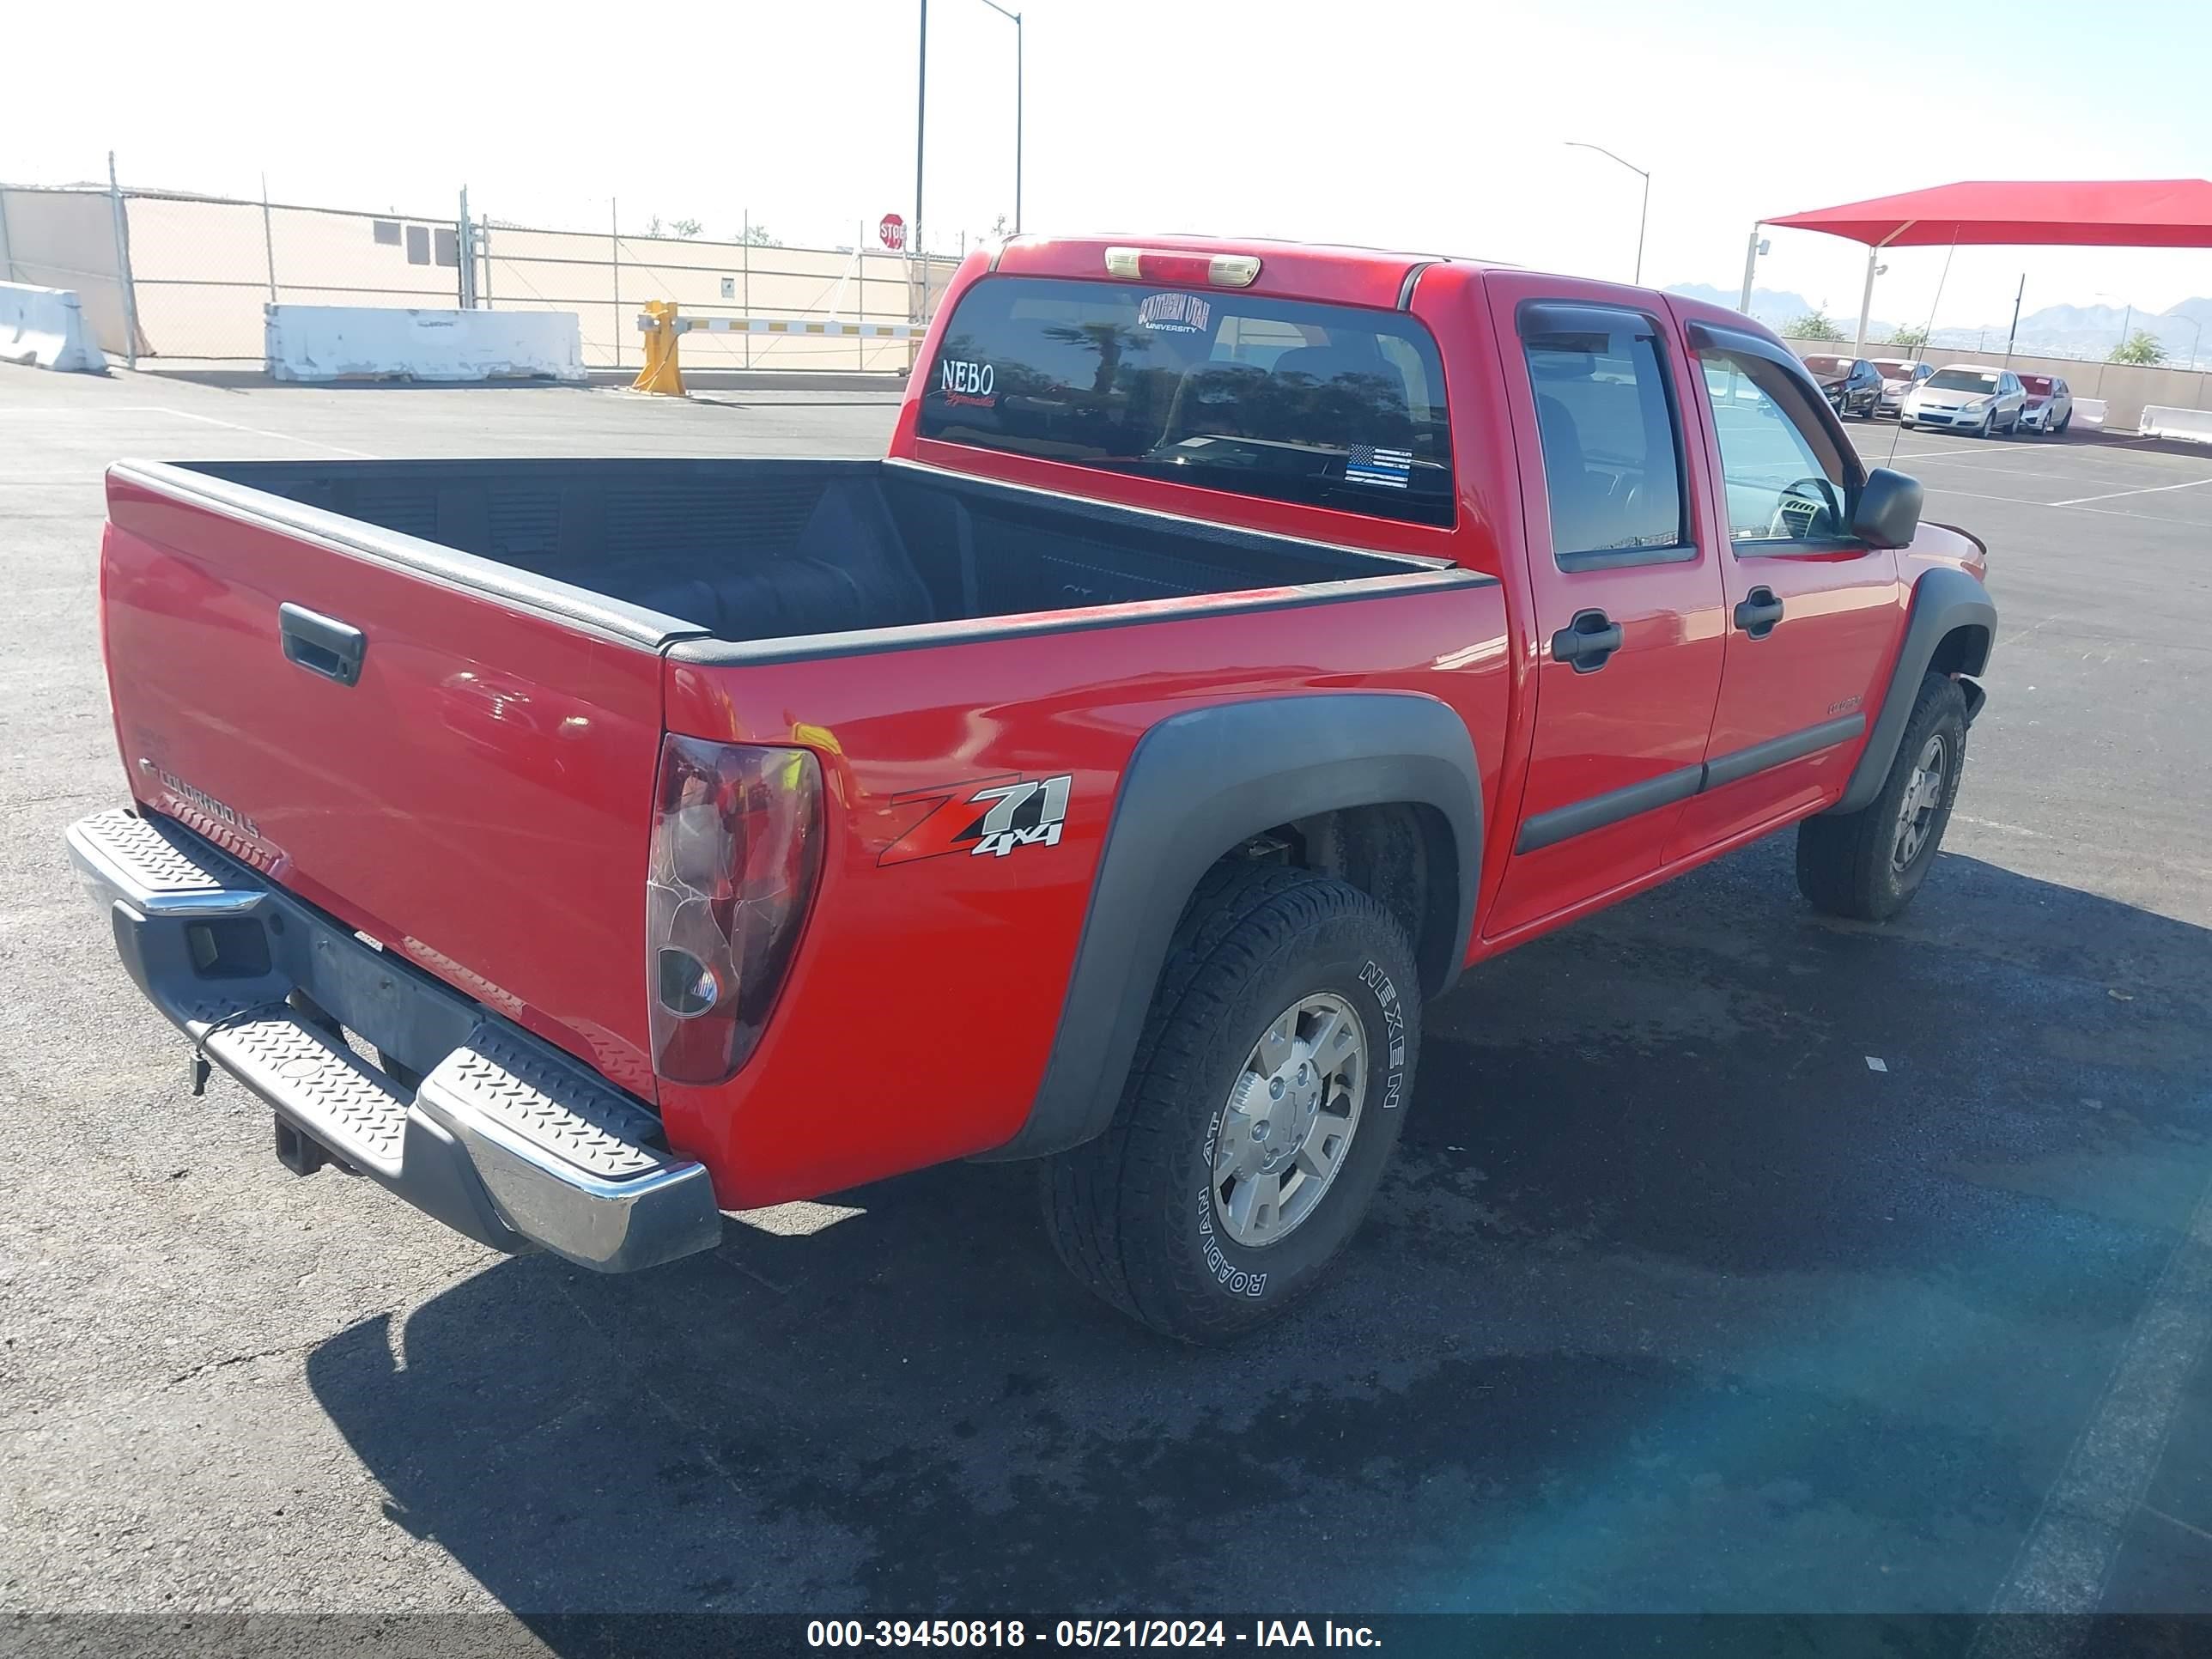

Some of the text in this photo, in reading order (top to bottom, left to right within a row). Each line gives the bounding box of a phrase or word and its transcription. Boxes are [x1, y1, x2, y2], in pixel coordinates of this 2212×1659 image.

[1138, 293, 1211, 332] SOUTHERN UTAH
[1146, 322, 1197, 333] UNIVERSITY
[941, 359, 994, 395] NEBO
[159, 769, 236, 825] COLORADO
[877, 772, 1073, 868] Z71
[1358, 960, 1405, 1109] NEXEN
[1197, 1111, 1267, 1297] ROADIAN AT
